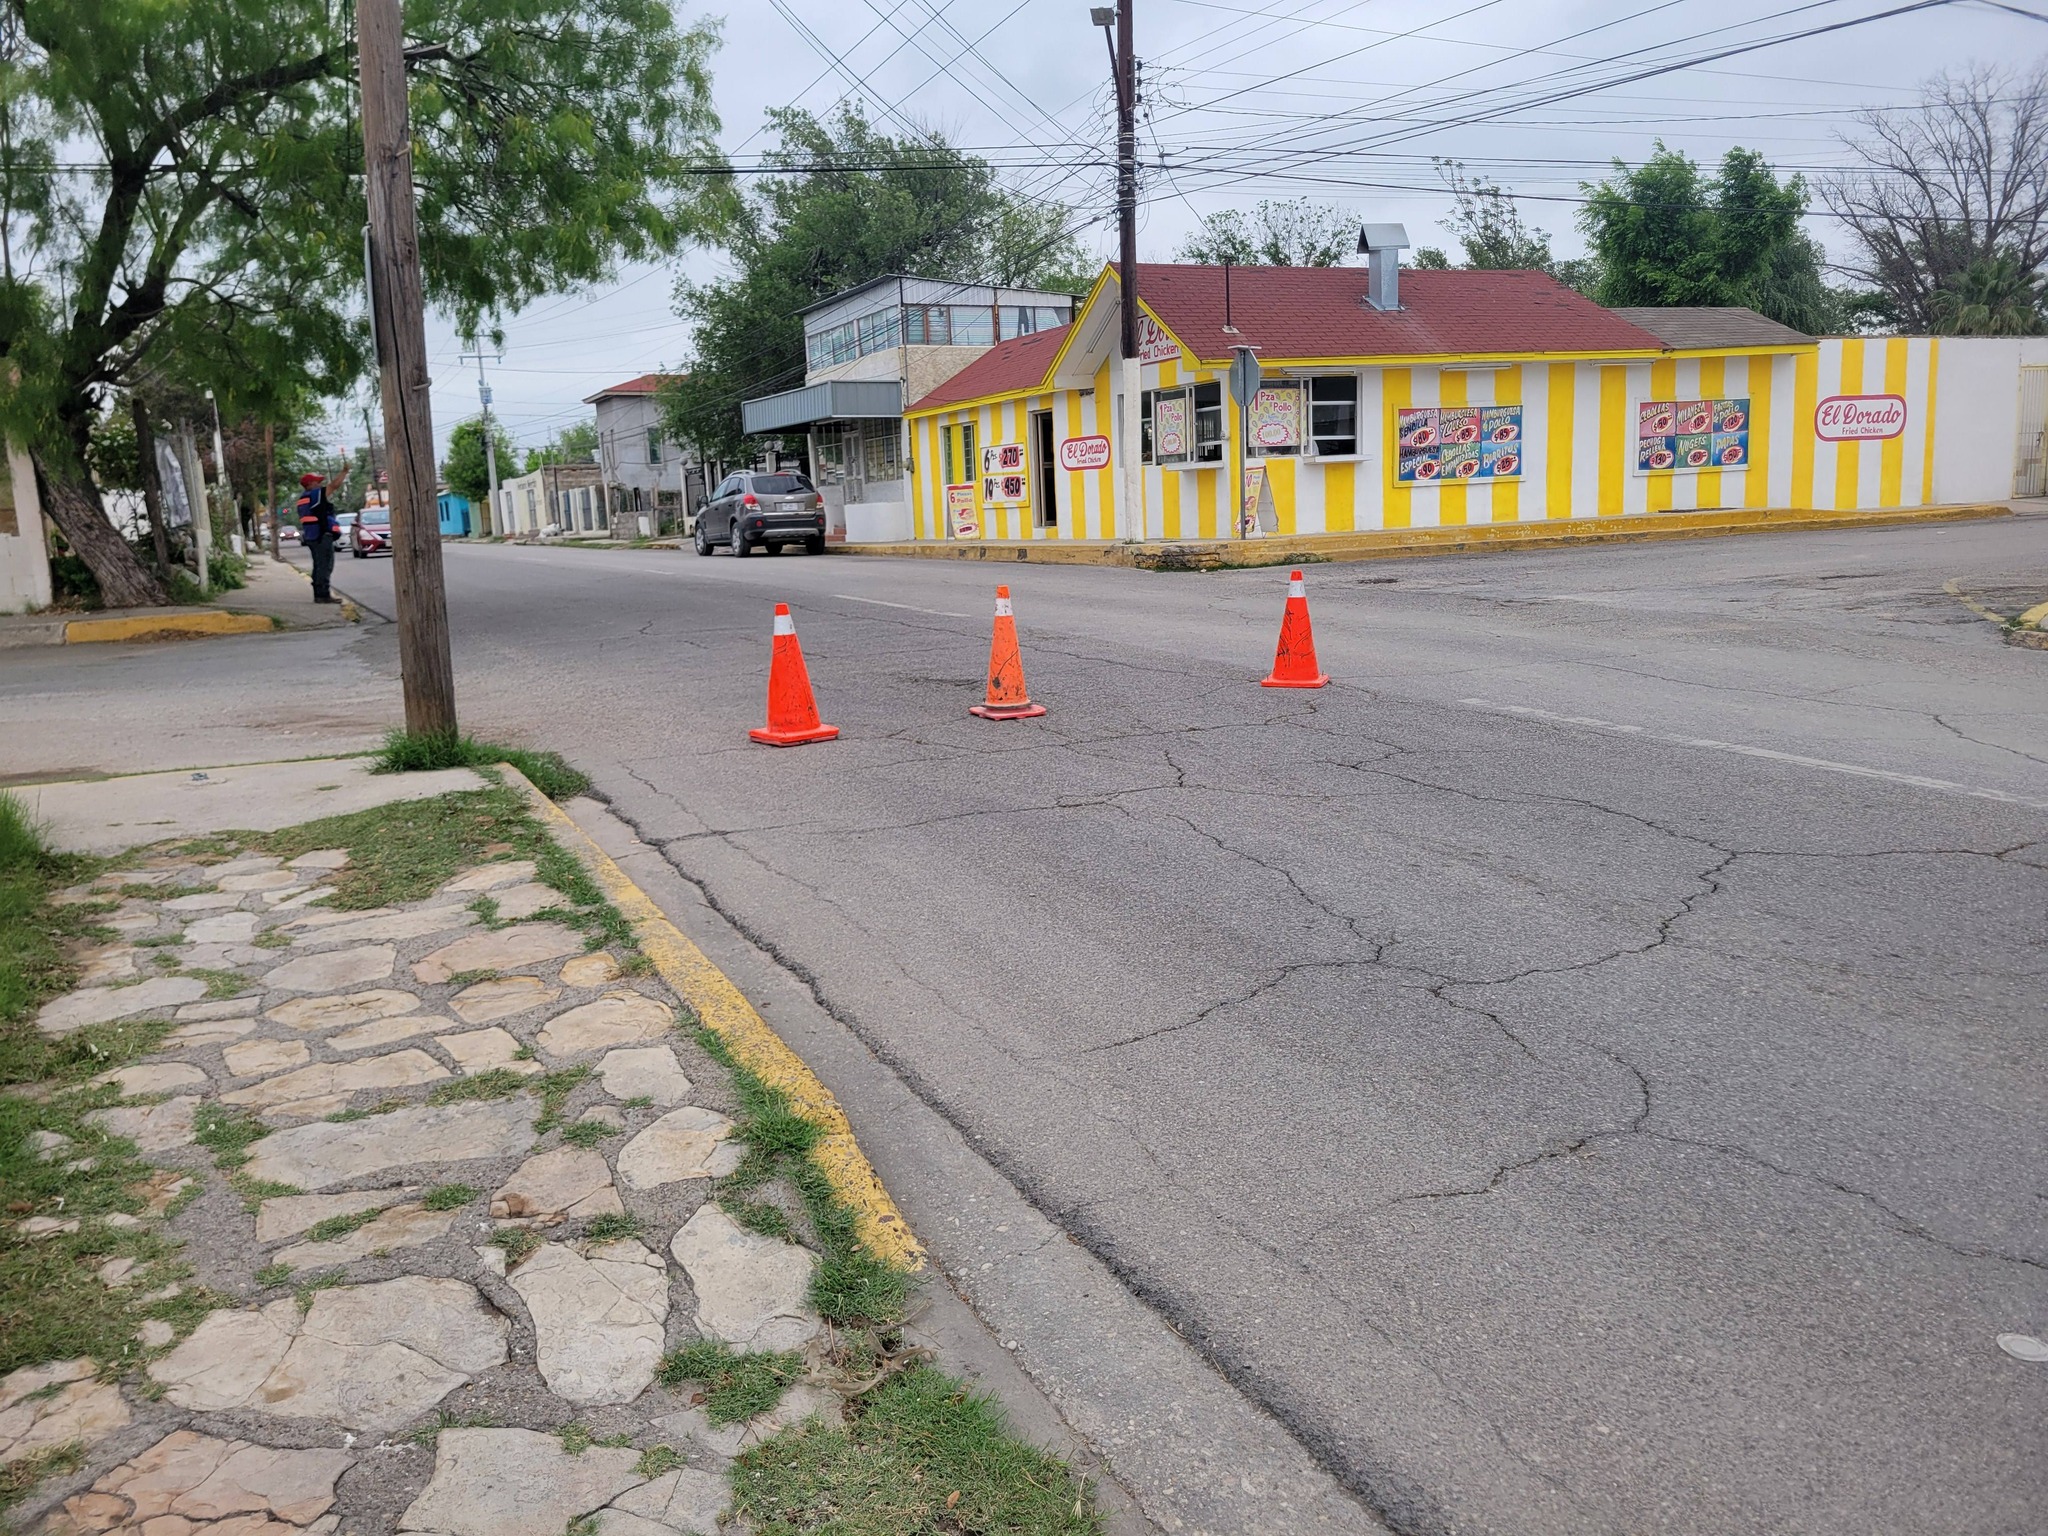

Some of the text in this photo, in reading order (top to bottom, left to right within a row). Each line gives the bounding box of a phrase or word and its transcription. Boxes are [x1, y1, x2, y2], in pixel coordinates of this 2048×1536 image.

[1139, 344, 1179, 360] ried Chicken
[1260, 391, 1275, 401] Pza
[1273, 402, 1292, 411] Pollo
[1822, 402, 1902, 426] El Dorado
[1488, 416, 1511, 432] POLLO
[1842, 427, 1858, 435] Fried
[1067, 440, 1107, 459] El Dorado
[1483, 443, 1519, 469] BURRITOS
[984, 449, 990, 473] 6
[1401, 454, 1432, 474] ESPECIAL
[950, 492, 956, 503] 6
[984, 477, 994, 501] 10
